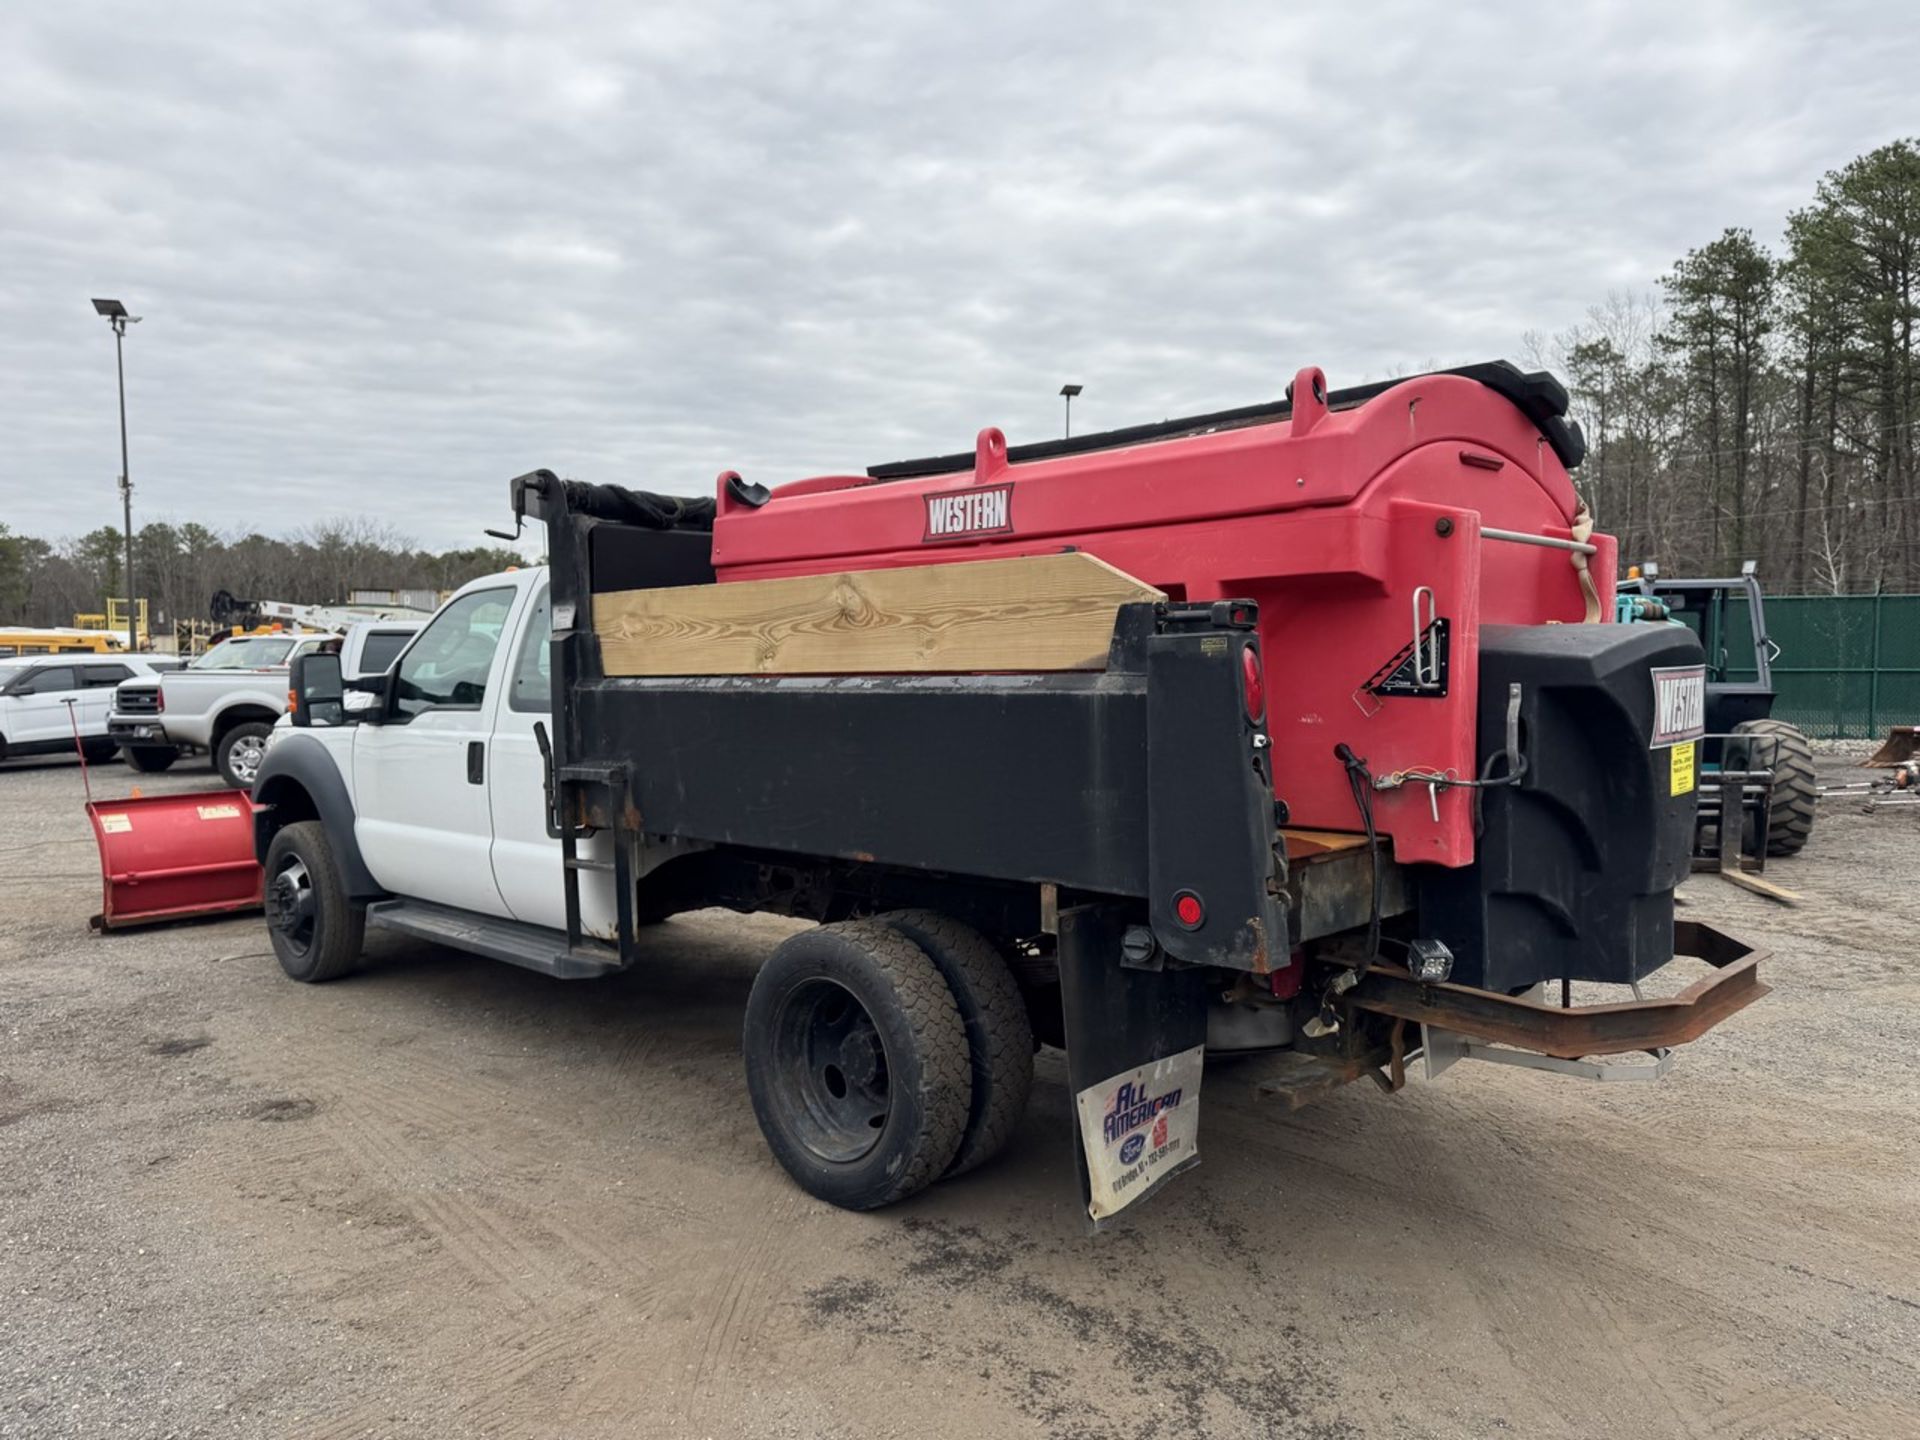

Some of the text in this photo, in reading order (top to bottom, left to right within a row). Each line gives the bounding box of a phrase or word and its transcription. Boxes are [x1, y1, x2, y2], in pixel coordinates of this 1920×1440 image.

[929, 490, 1007, 535] WESTERN
[1104, 1088, 1182, 1146] AMERICAN
[1115, 1082, 1147, 1115] ALL
